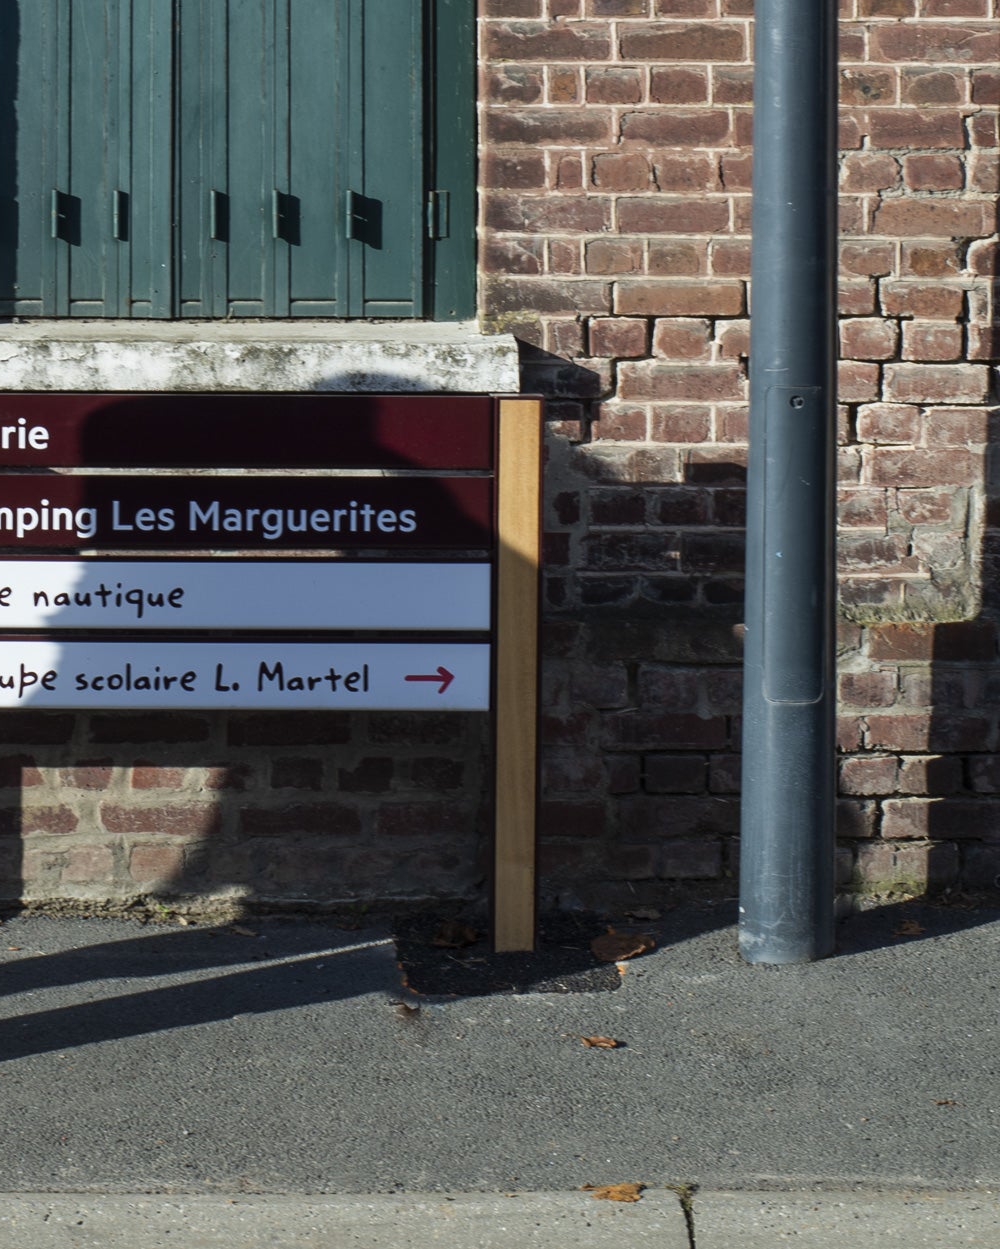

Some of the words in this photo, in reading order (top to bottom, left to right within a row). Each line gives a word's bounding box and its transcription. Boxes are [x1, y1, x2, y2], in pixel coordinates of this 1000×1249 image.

[112, 500, 175, 532] Les
[189, 500, 417, 540] Marguerites
[33, 583, 185, 619] nautique
[74, 662, 198, 693] scolaire
[214, 662, 241, 693] L.
[256, 660, 371, 693] Martel
